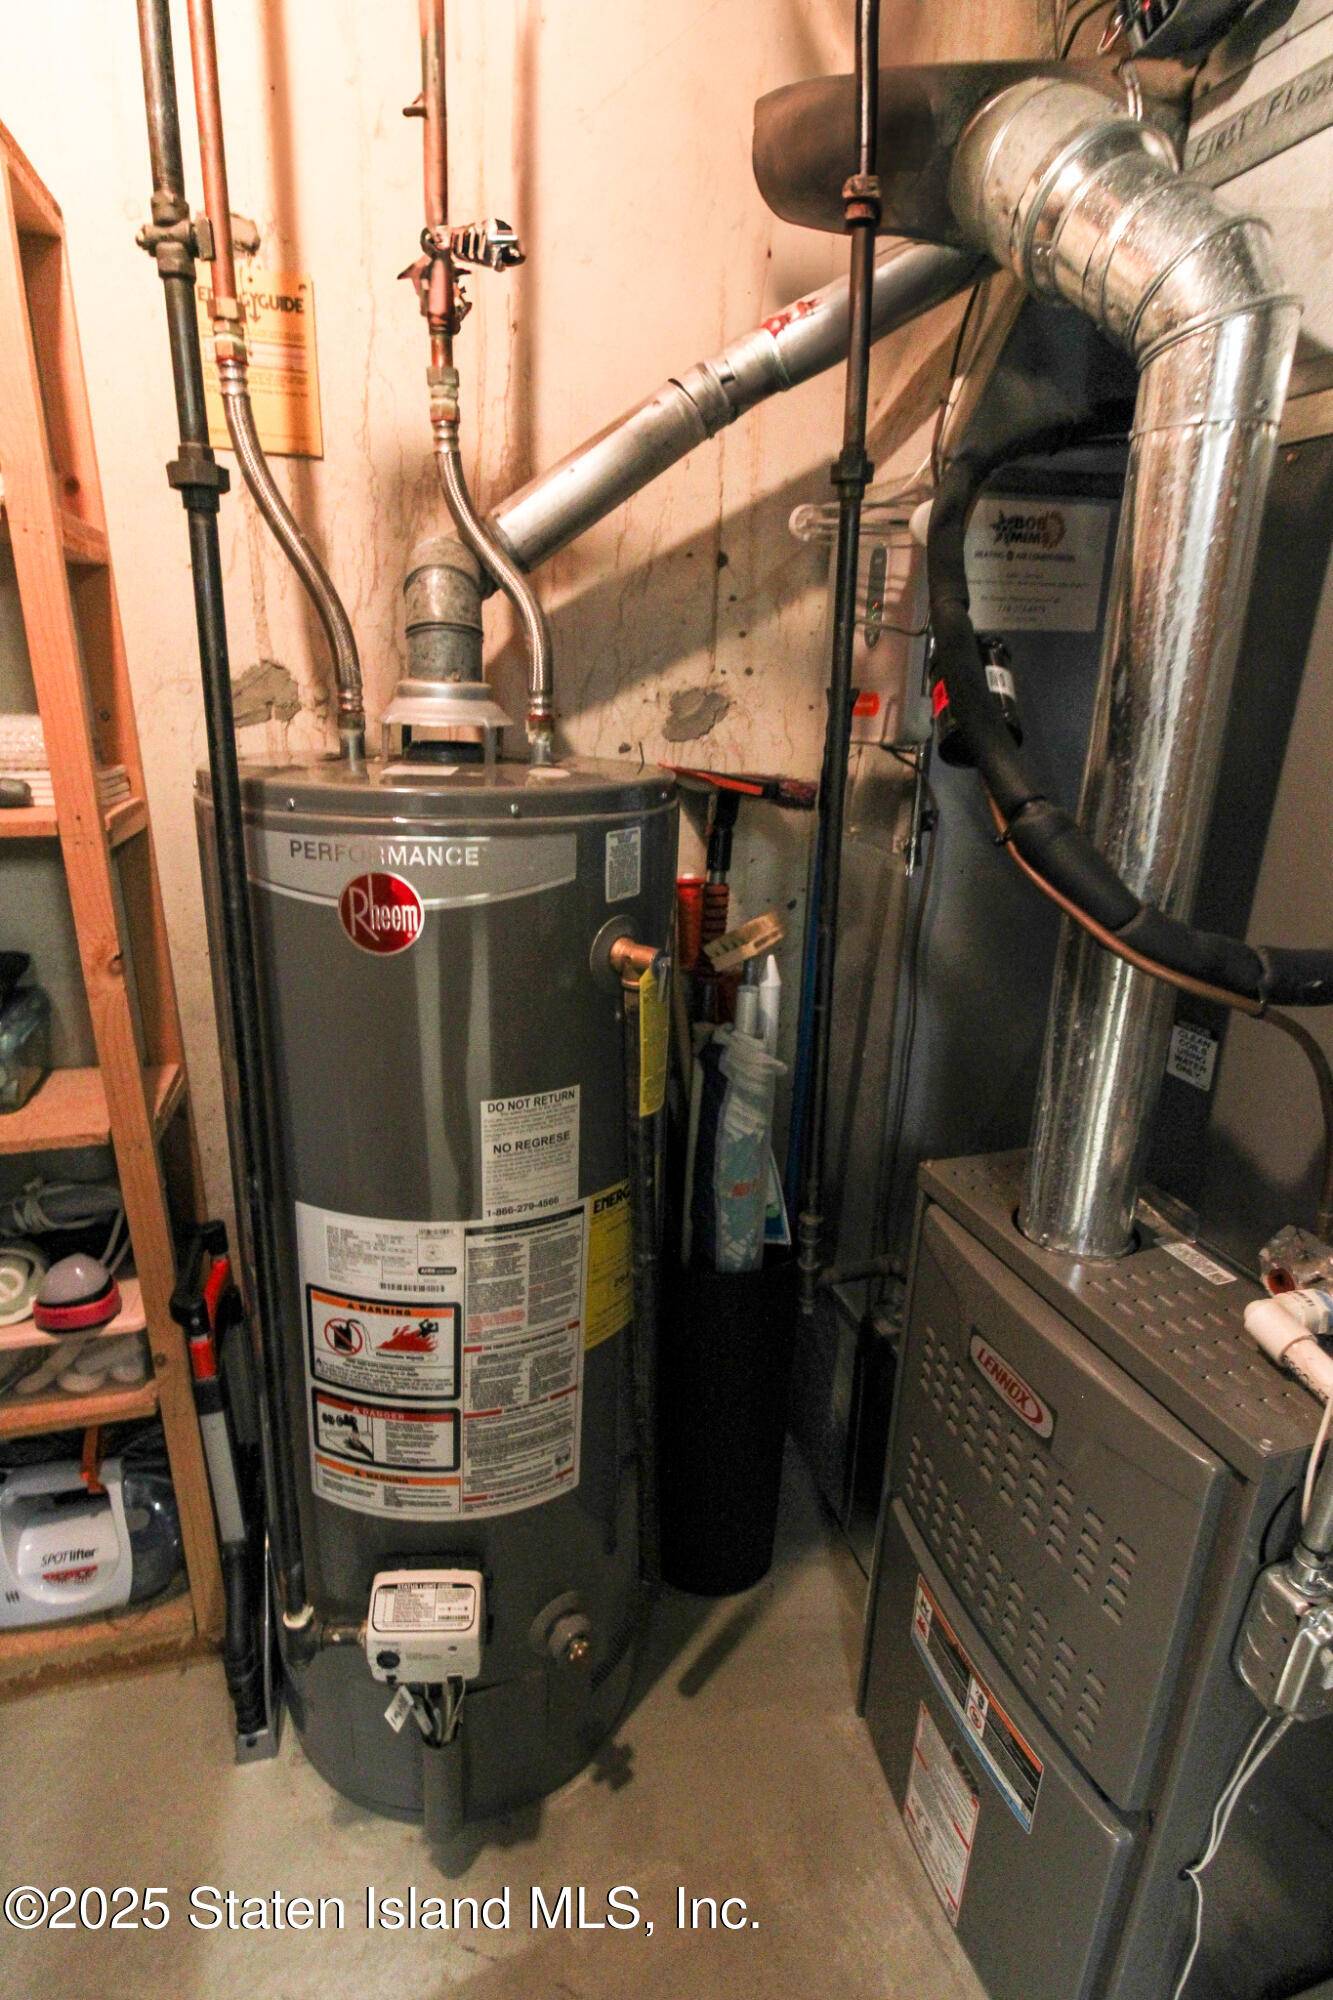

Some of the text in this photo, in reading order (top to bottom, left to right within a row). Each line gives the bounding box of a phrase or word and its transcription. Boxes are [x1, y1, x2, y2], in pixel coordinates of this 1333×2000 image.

[349, 874, 418, 941] Rheem
[487, 1088, 575, 1114] DO NOT RETURN
[493, 1130, 571, 1155] NO REGRESE
[359, 1303, 411, 1316] WARNING
[977, 1348, 1030, 1412] LENNOX
[362, 1408, 404, 1421] DANGER
